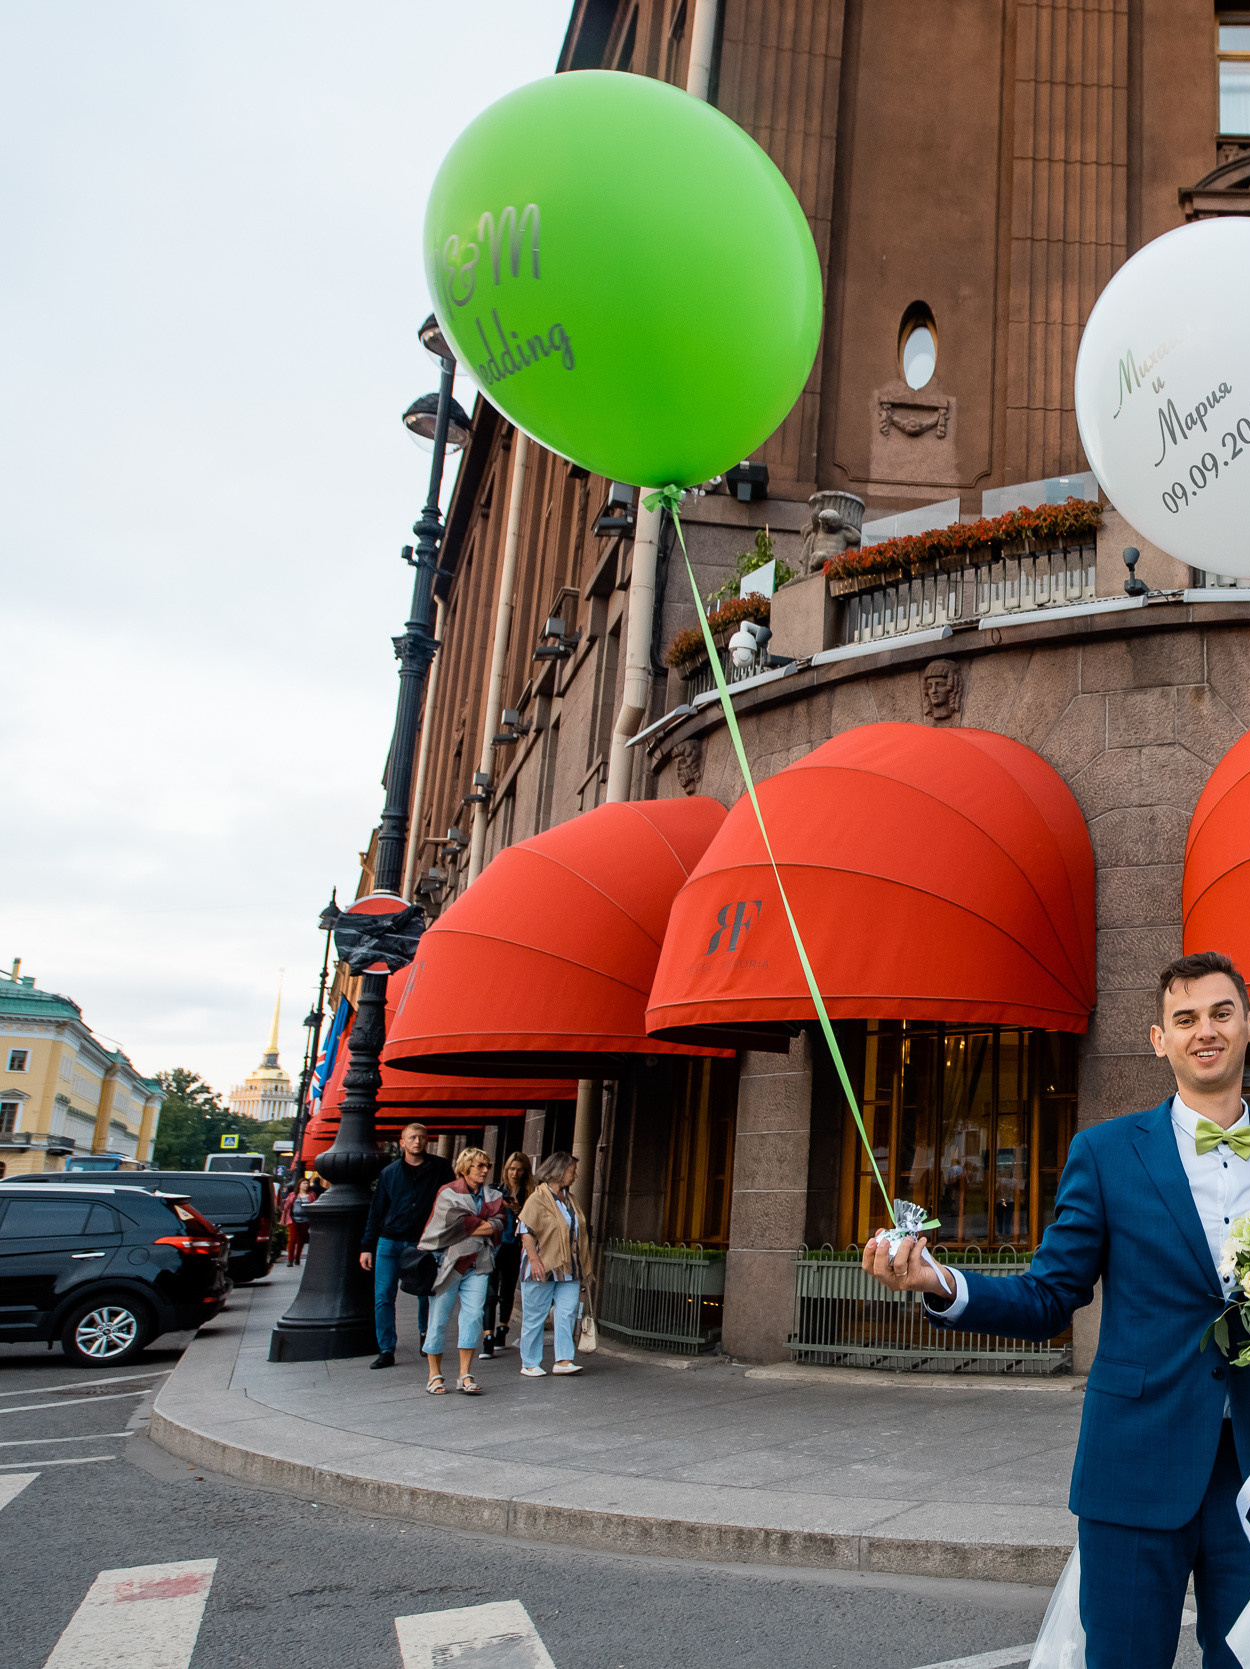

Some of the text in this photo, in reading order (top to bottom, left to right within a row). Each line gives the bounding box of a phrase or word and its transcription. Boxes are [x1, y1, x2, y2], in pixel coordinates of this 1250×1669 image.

[475, 307, 576, 386] edding
[1151, 376, 1166, 394] и
[1154, 382, 1233, 467] Мария
